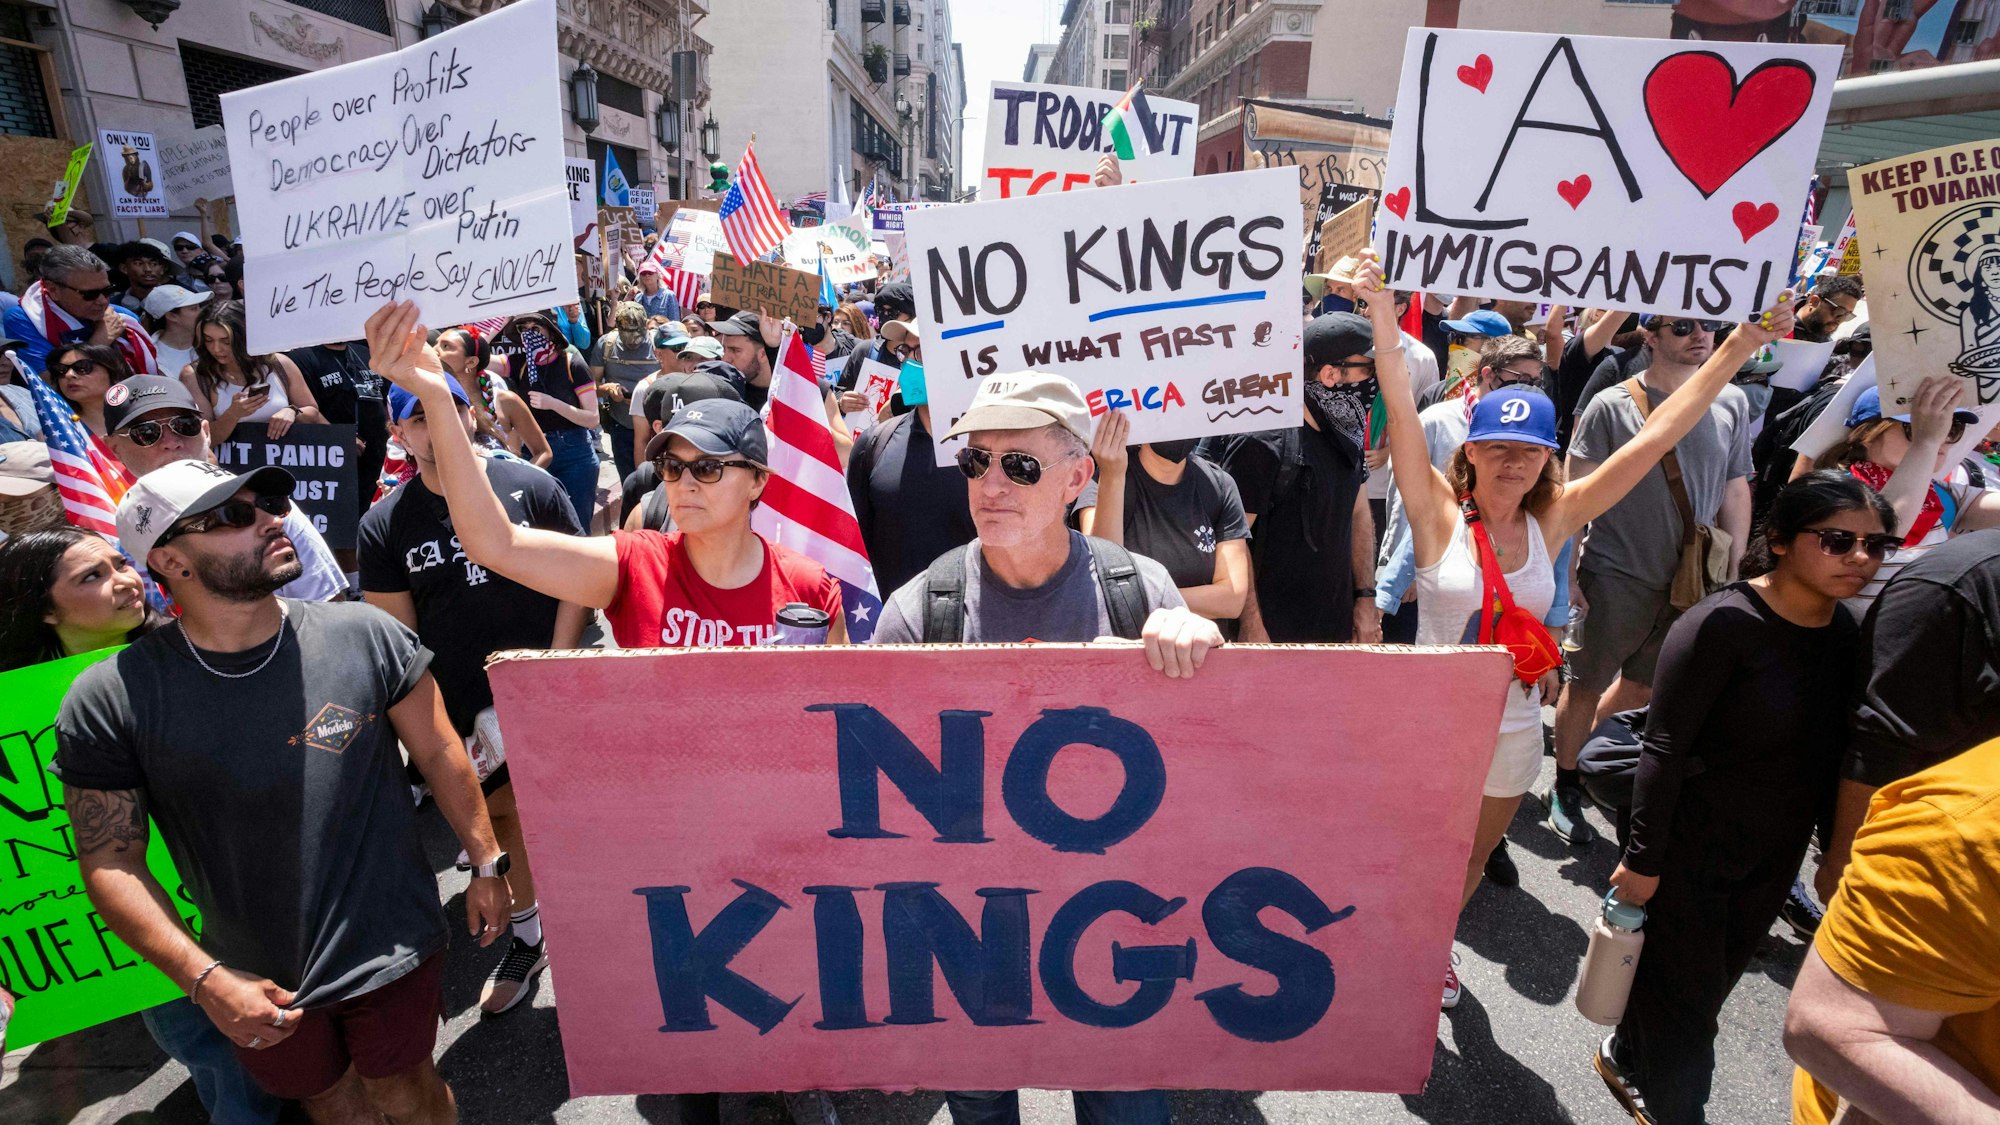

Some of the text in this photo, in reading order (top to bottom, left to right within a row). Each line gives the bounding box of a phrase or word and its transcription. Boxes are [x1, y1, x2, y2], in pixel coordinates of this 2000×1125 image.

[249, 48, 473, 147] People over Profits
[106, 133, 150, 148] ONLY YOU
[993, 87, 1116, 153] TROOP
[1415, 32, 1643, 230] LA
[159, 143, 188, 164] OPLE
[165, 162, 190, 178] DEPORT
[270, 113, 452, 192] Democracy Over
[422, 119, 537, 180] Dictators
[165, 181, 192, 197] THINK
[1861, 159, 1928, 195] KEEP
[1932, 148, 1988, 179] I.C.E
[116, 205, 166, 213] FACIST LIARS
[1339, 191, 1358, 202] was
[1891, 172, 2000, 215] TOVAAN
[284, 186, 475, 250] UKRAINE over
[456, 199, 521, 245] Putin
[878, 212, 904, 222] IMMIGR
[885, 221, 904, 229] RIGHT
[714, 252, 809, 292] I HATE A
[801, 253, 856, 265] BUIT THIS
[927, 241, 1028, 324] NO
[1063, 215, 1285, 305] KINGS
[1386, 229, 1773, 324] IMMIGRANTS!
[270, 243, 562, 319] We The People Say ENOUGH
[788, 292, 818, 311] ASS
[739, 295, 799, 319] BITCH
[959, 322, 1237, 380] IS WHAT FIRST
[1084, 371, 1293, 418] ERICA GREAT
[1500, 398, 1531, 424] D
[213, 440, 345, 468] N'T PANIC
[292, 480, 339, 501] UST
[661, 607, 776, 648] STOP TH
[316, 719, 354, 739] Modelo
[803, 702, 1167, 855] NO
[631, 866, 1357, 1043] KINGS
